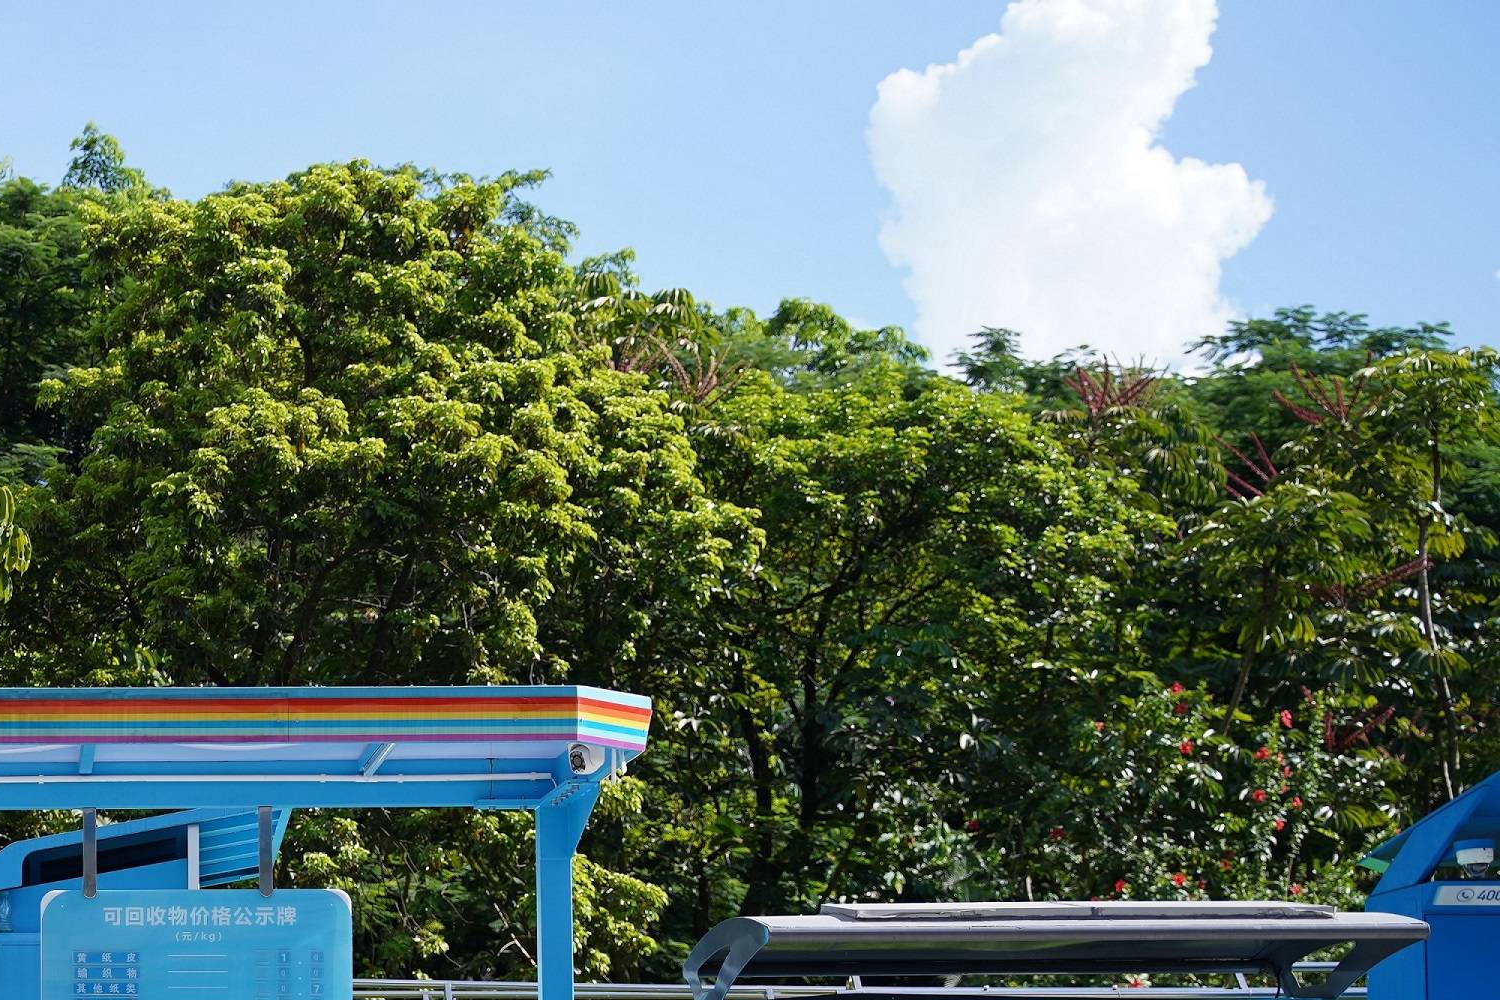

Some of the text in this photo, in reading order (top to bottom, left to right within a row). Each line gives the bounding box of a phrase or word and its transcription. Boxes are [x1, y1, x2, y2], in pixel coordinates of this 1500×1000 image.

[103, 906, 297, 926] 可回收物价格公示牌
[77, 952, 137, 963] 黄纸皮
[77, 967, 137, 978] 编织物
[77, 983, 137, 994] 其他纸类
